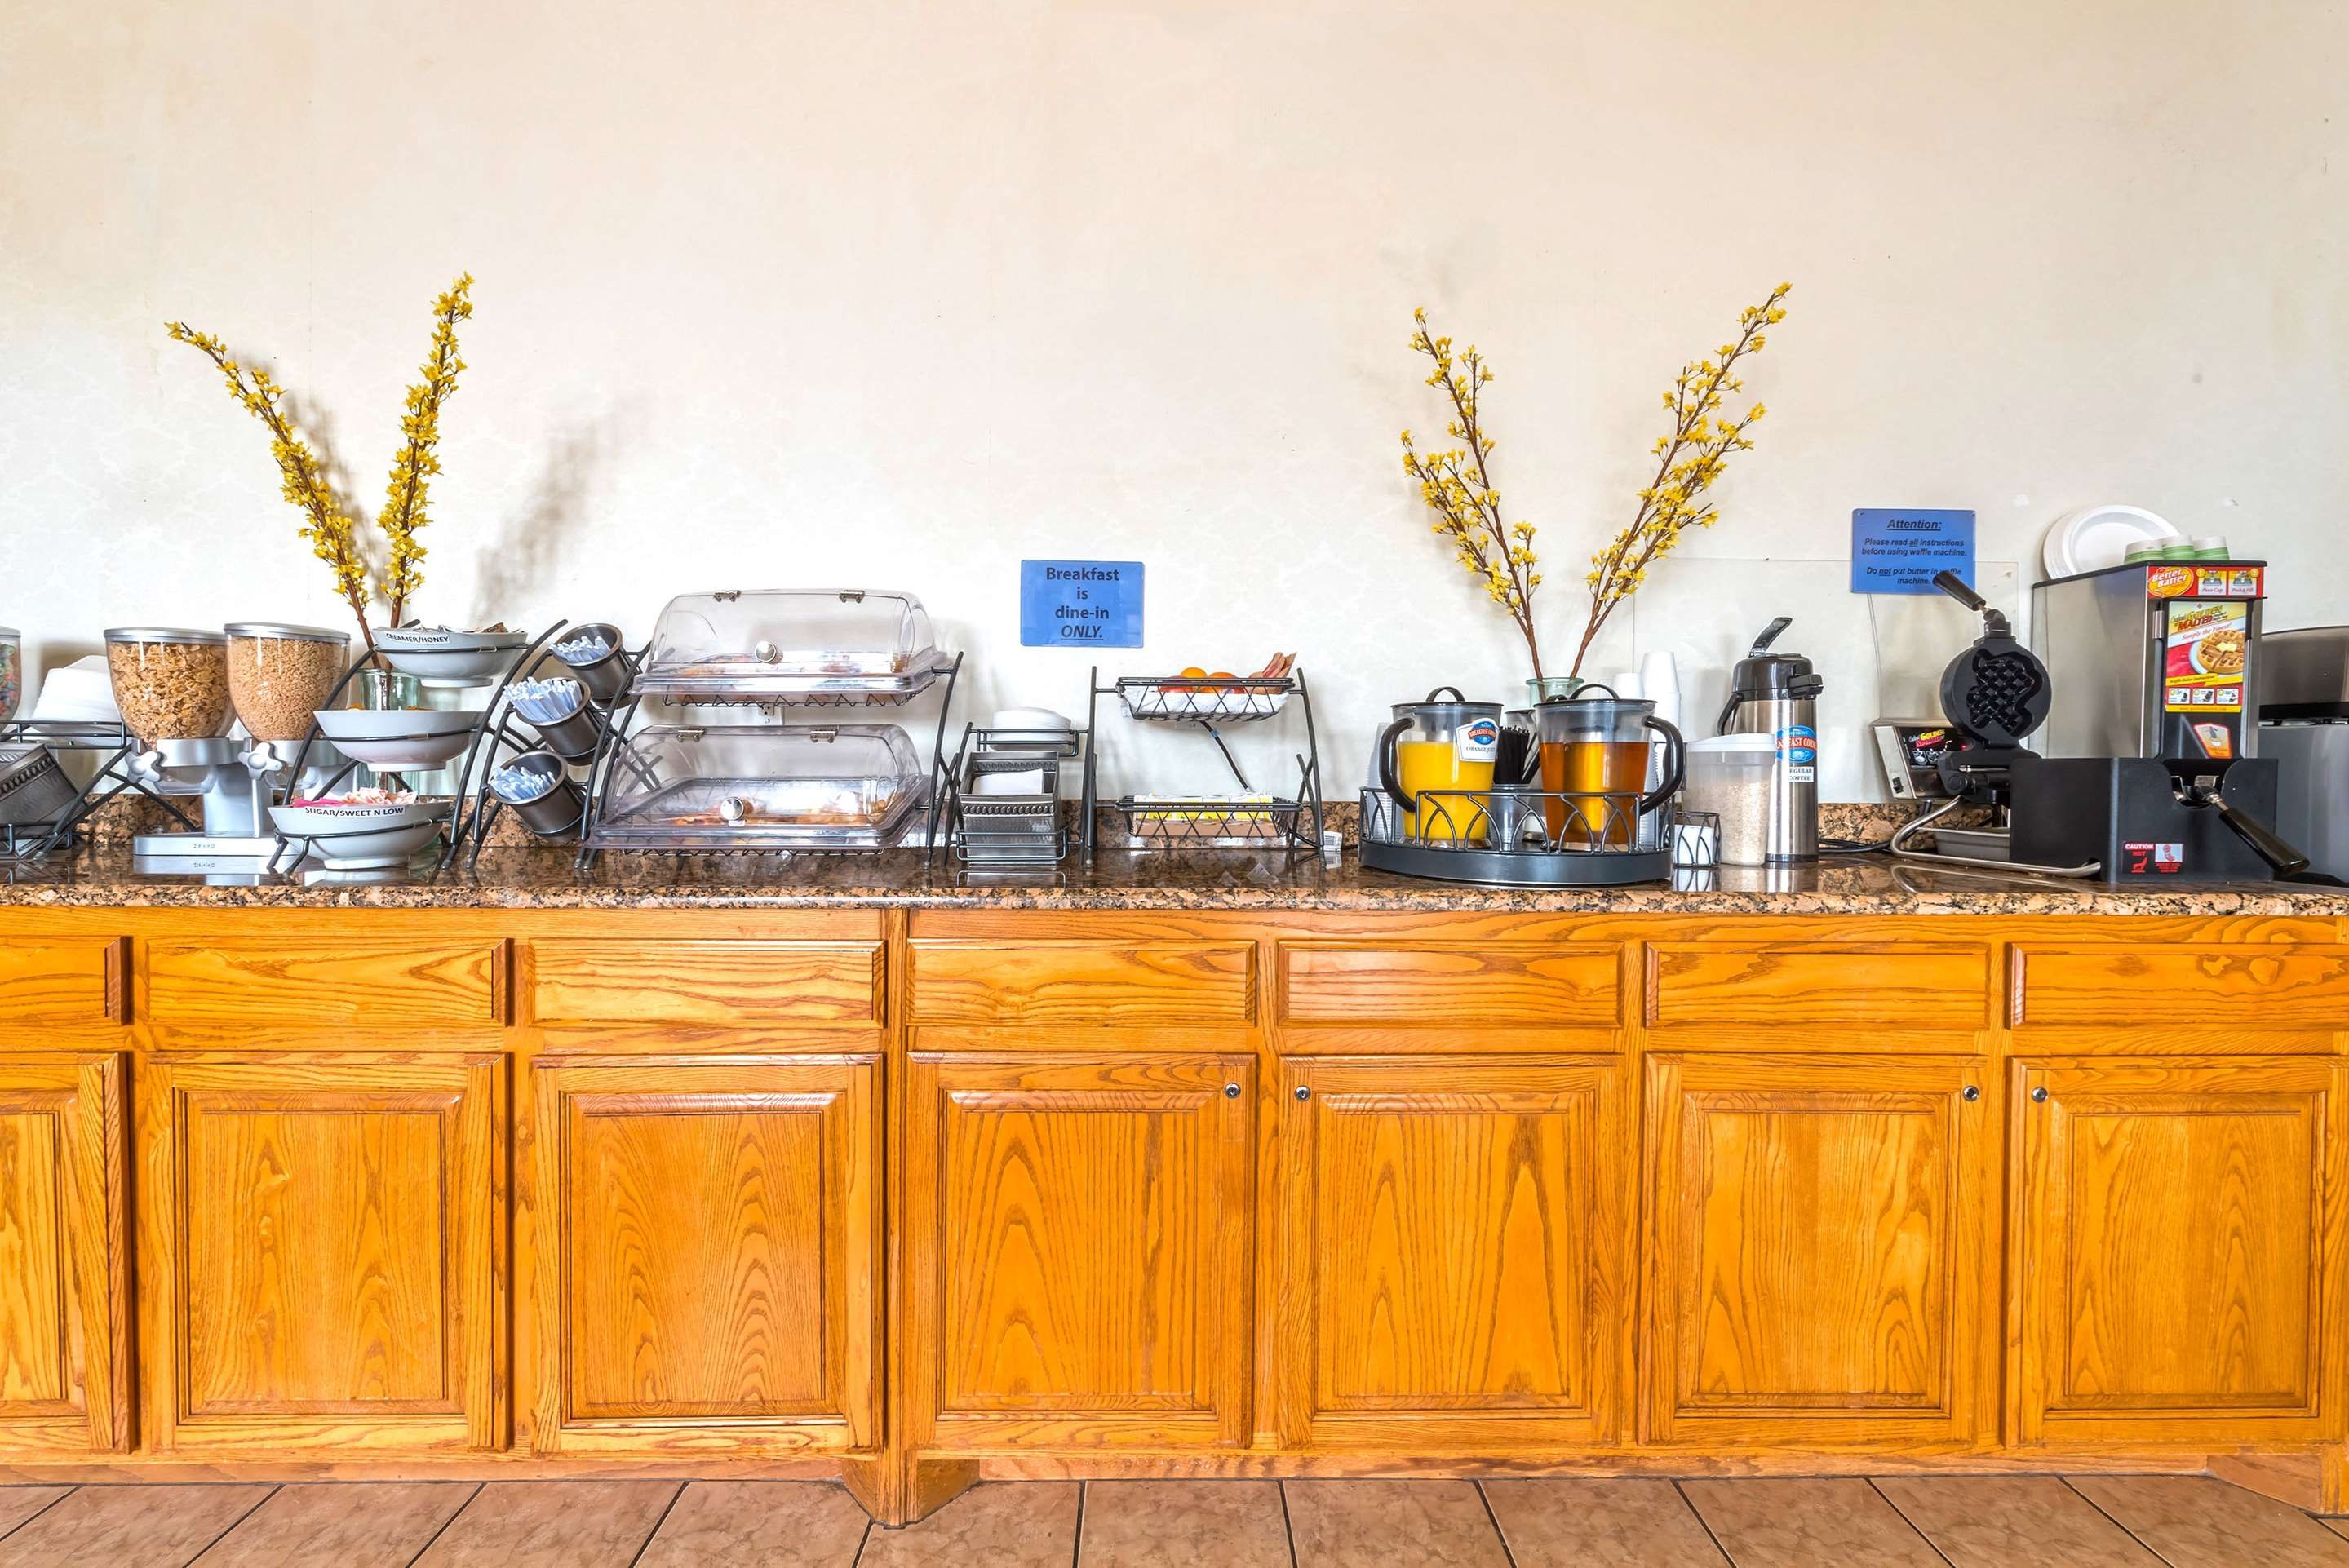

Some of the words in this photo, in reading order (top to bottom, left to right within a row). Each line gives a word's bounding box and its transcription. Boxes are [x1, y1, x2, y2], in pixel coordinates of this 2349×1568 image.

[1886, 520, 1942, 531] Attention:
[1909, 538, 1918, 547] all
[1886, 548, 1908, 556] using
[1046, 567, 1120, 581] Breakfast
[1892, 568, 1905, 576] put
[2152, 569, 2182, 582] Better
[2157, 574, 2187, 588] Batter
[1077, 587, 1088, 600] is
[1055, 605, 1110, 619] dine-in
[386, 633, 449, 644] CREAMER/HONEY
[1061, 625, 1104, 640] ONLY.
[305, 807, 371, 817] SUGAR/SWEET
